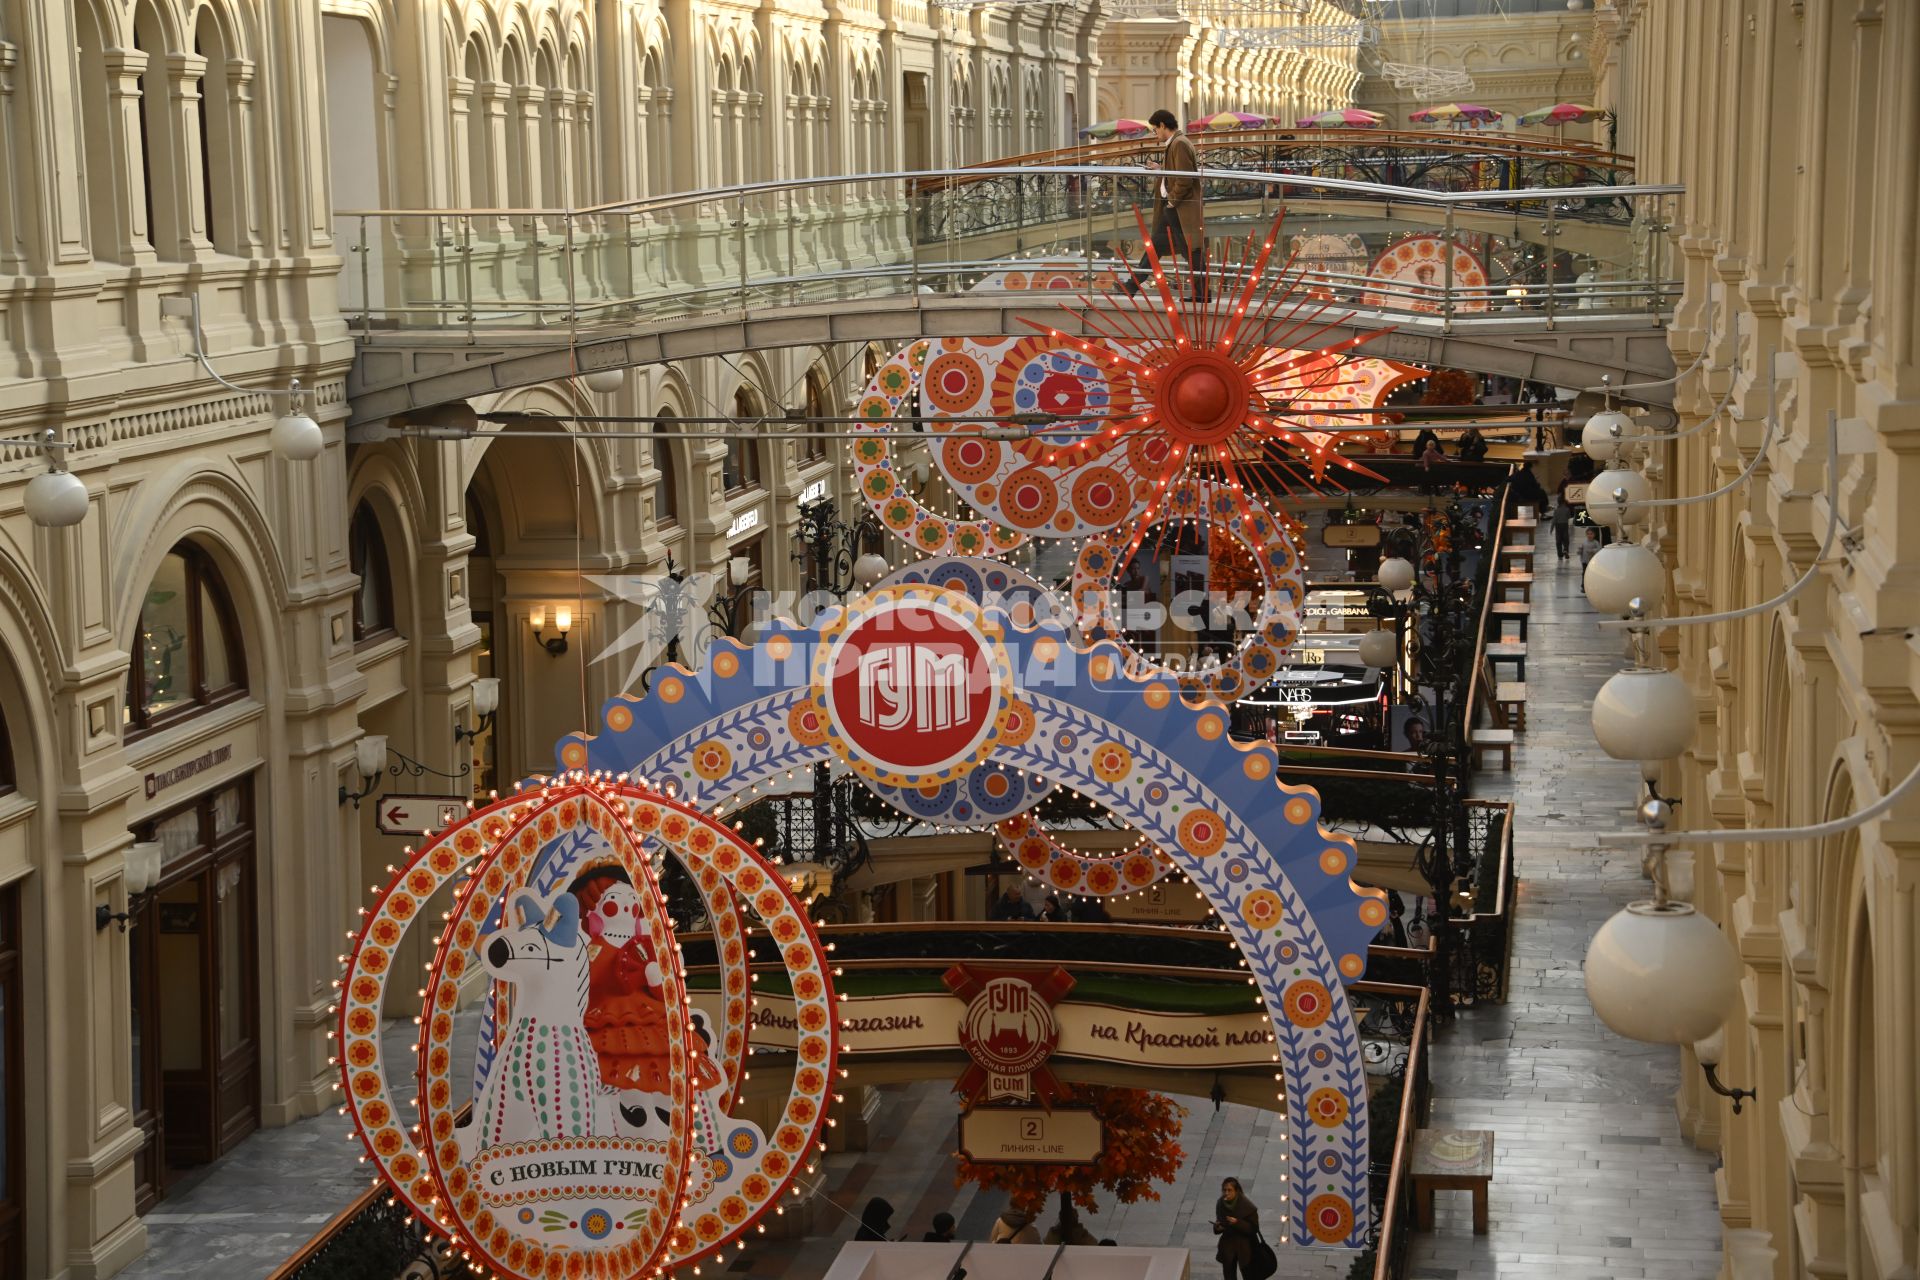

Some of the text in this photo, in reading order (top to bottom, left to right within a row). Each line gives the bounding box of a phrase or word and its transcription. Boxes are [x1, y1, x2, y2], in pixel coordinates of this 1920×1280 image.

[1279, 688, 1311, 702] NARS
[1153, 891, 1160, 902] 2
[989, 983, 1028, 1013] ГУМ
[1090, 1023, 1118, 1041] на
[1125, 1022, 1220, 1052] Красной
[971, 1046, 1047, 1073] КРАСНАЯ ПЛОЩАДЬ
[993, 1078, 1024, 1091] GUM
[1027, 1122, 1037, 1136] 2
[1000, 1144, 1064, 1154] ЛИНИЯ LINE
